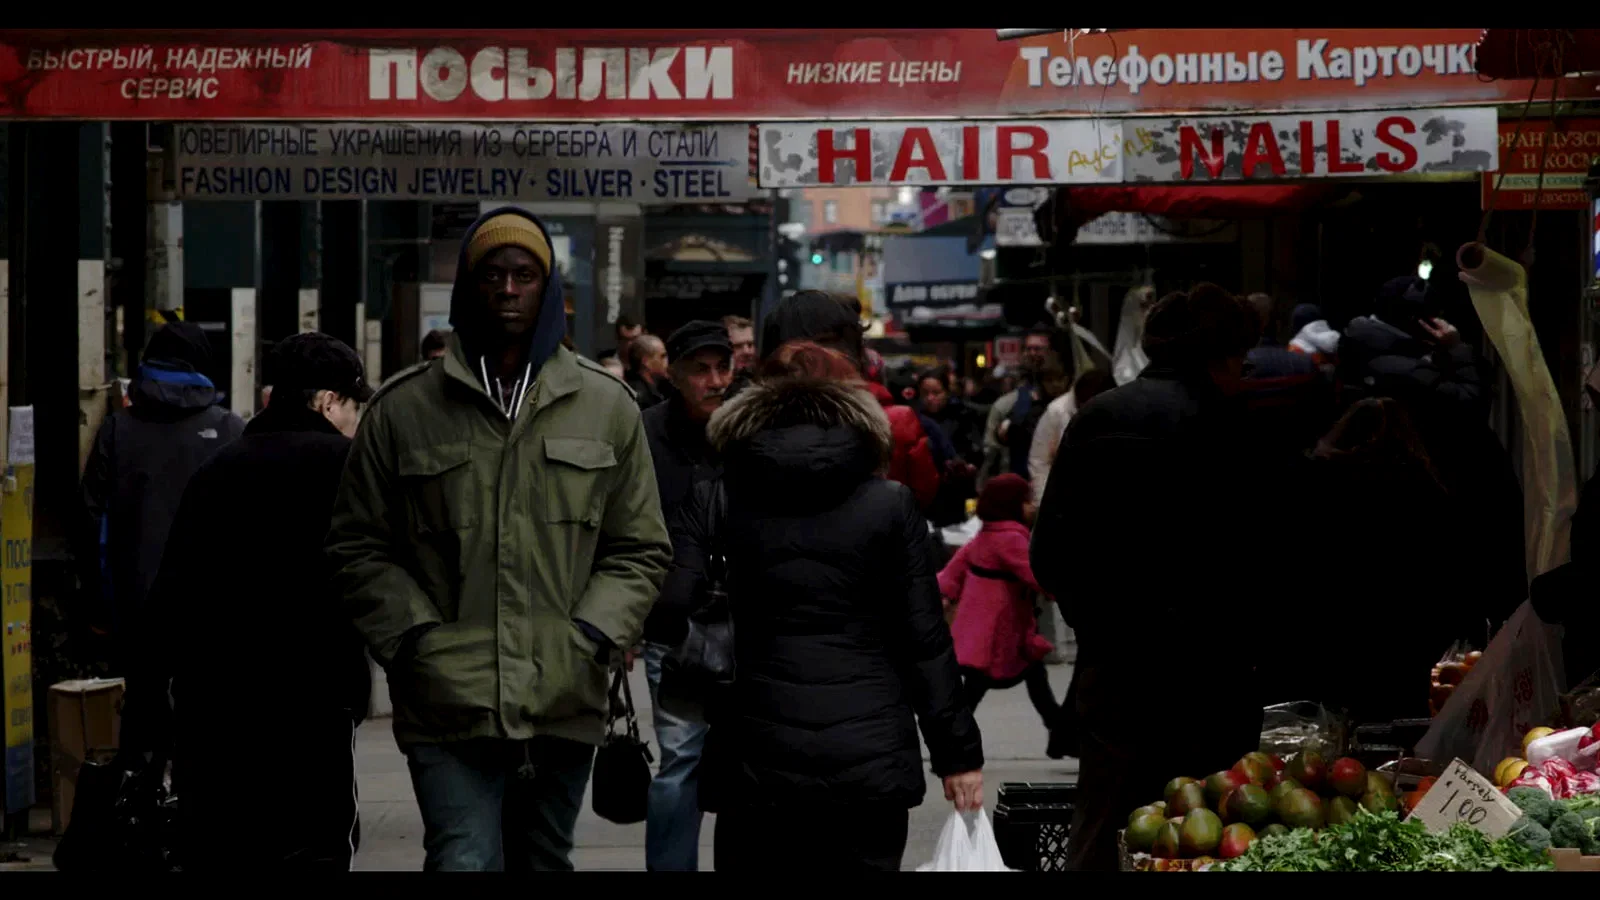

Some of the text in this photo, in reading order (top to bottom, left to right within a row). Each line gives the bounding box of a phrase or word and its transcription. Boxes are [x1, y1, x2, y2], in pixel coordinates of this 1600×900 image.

[27, 44, 313, 72] БЫСТРЫЙ, НАДЕЖНЫЙ
[1020, 45, 1285, 93] Телефонные
[120, 78, 220, 99] СЕРВИС
[368, 46, 733, 102] ПОСЫЛКИ
[786, 61, 962, 87] НИЗКИЕ ЦЕНЫ
[180, 127, 718, 157] ЮВЕЛИРНЫЕ УКРАШЕНИЯ ИЗ СЕРЕБРА И СТАЛИ
[816, 126, 1053, 182] HAIR
[1179, 117, 1418, 179] NAILS
[181, 167, 730, 197] FASHION DESIGN JEWELRY SILVER STEEL
